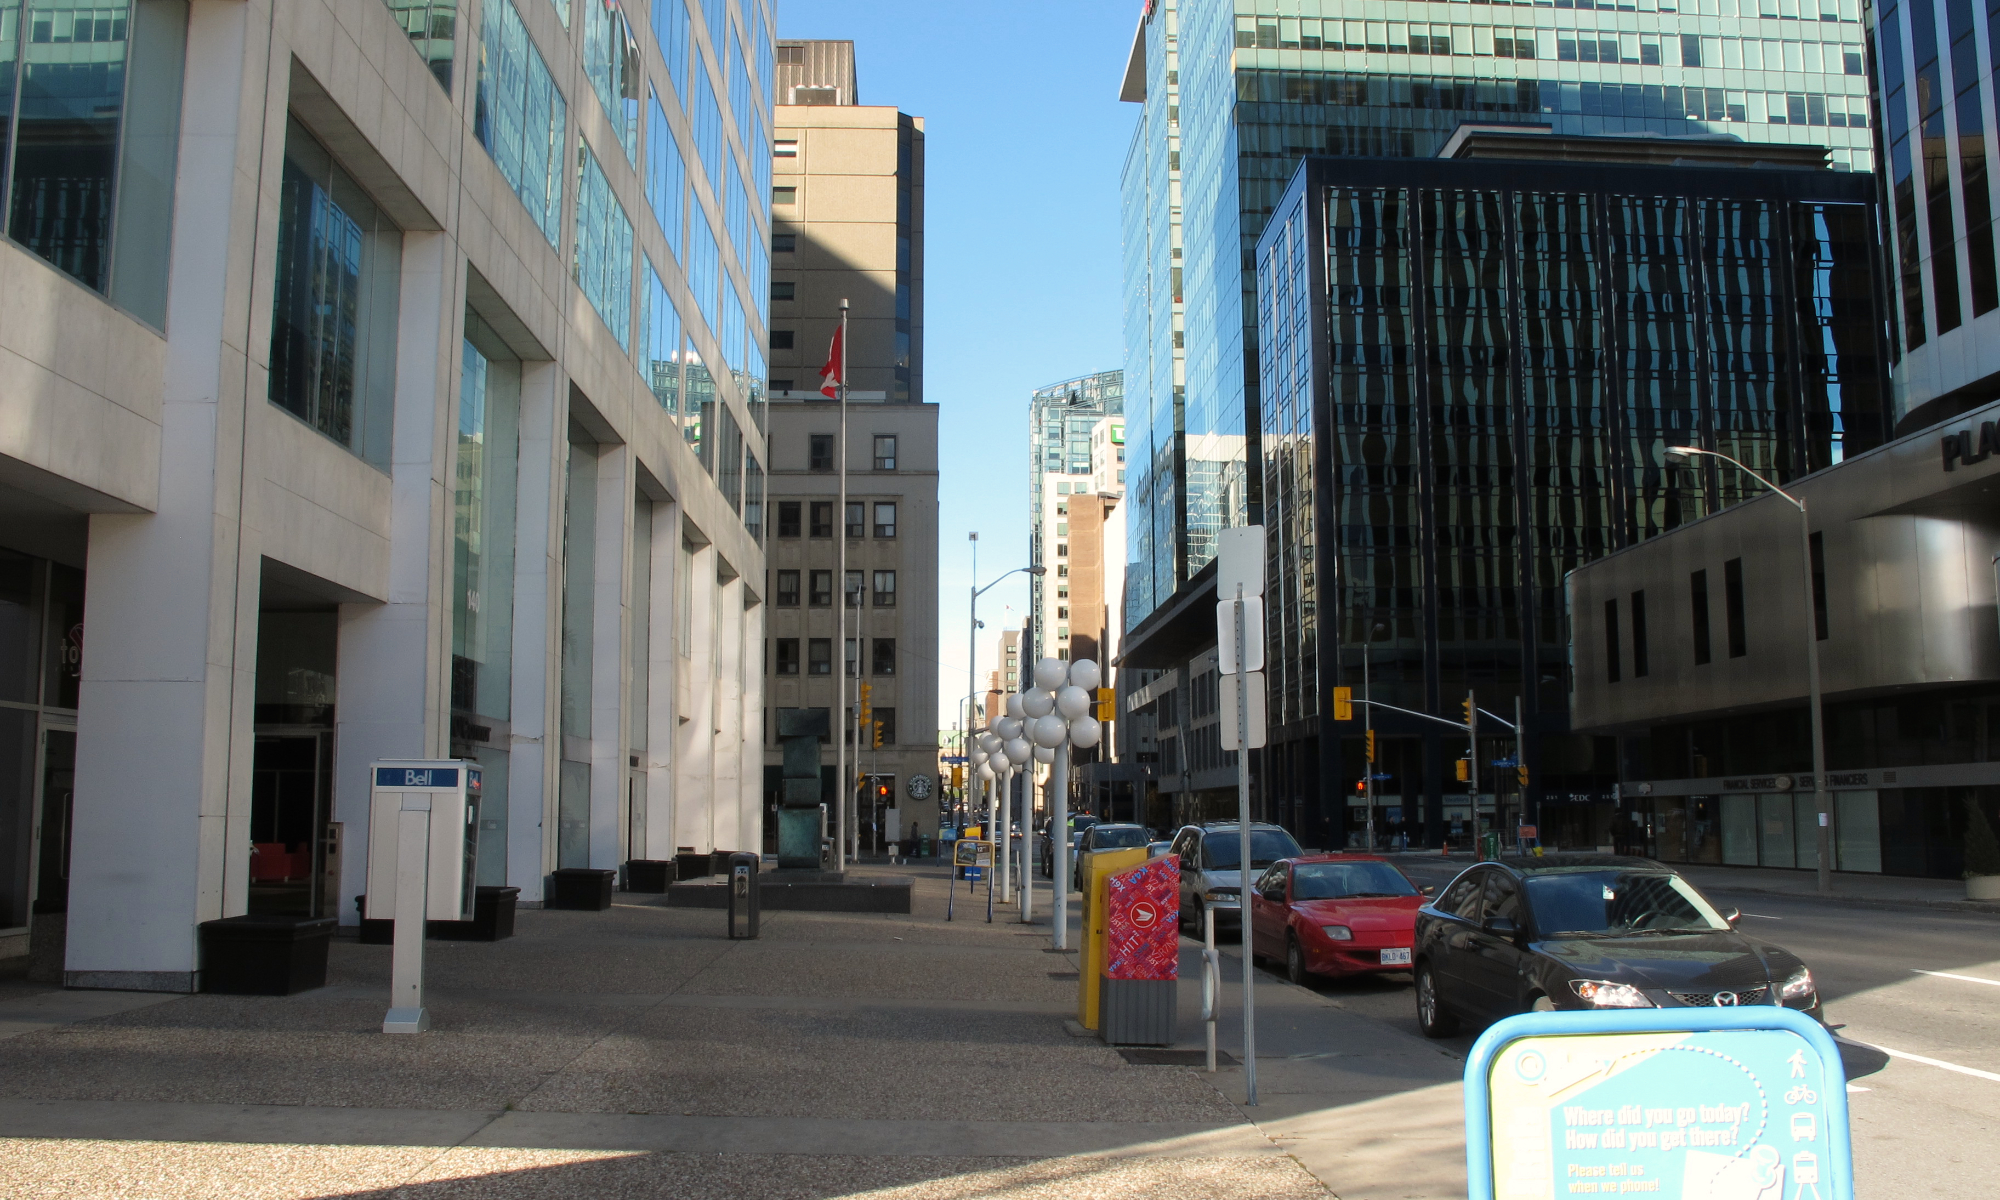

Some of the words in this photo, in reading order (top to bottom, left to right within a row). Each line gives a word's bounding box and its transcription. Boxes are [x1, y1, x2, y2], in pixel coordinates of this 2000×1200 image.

[1941, 418, 2000, 472] PLA
[467, 588, 480, 613] 140
[404, 769, 432, 785] Bell
[1723, 779, 1749, 790] FINANCIAL
[1750, 777, 1776, 789] SERVICES
[1829, 773, 1868, 787] FINANCIERS
[1573, 794, 1591, 802] EDC
[1109, 876, 1125, 892] H9X
[1119, 936, 1139, 957] H1T
[1564, 1106, 1614, 1127] Where
[1618, 1104, 1641, 1125] did
[1645, 1108, 1673, 1129] you
[1676, 1108, 1696, 1128] go
[1700, 1102, 1750, 1127] today?
[1566, 1129, 1599, 1149] How
[1602, 1128, 1625, 1149] did
[1629, 1131, 1659, 1152] you
[1661, 1127, 1687, 1151] get
[1689, 1125, 1738, 1147] there?
[1568, 1163, 1607, 1178] Please
[1609, 1163, 1628, 1177] tell
[1631, 1164, 1644, 1176] us
[1569, 1180, 1599, 1194] when
[1601, 1182, 1617, 1193] we
[1620, 1178, 1660, 1195] phone!
